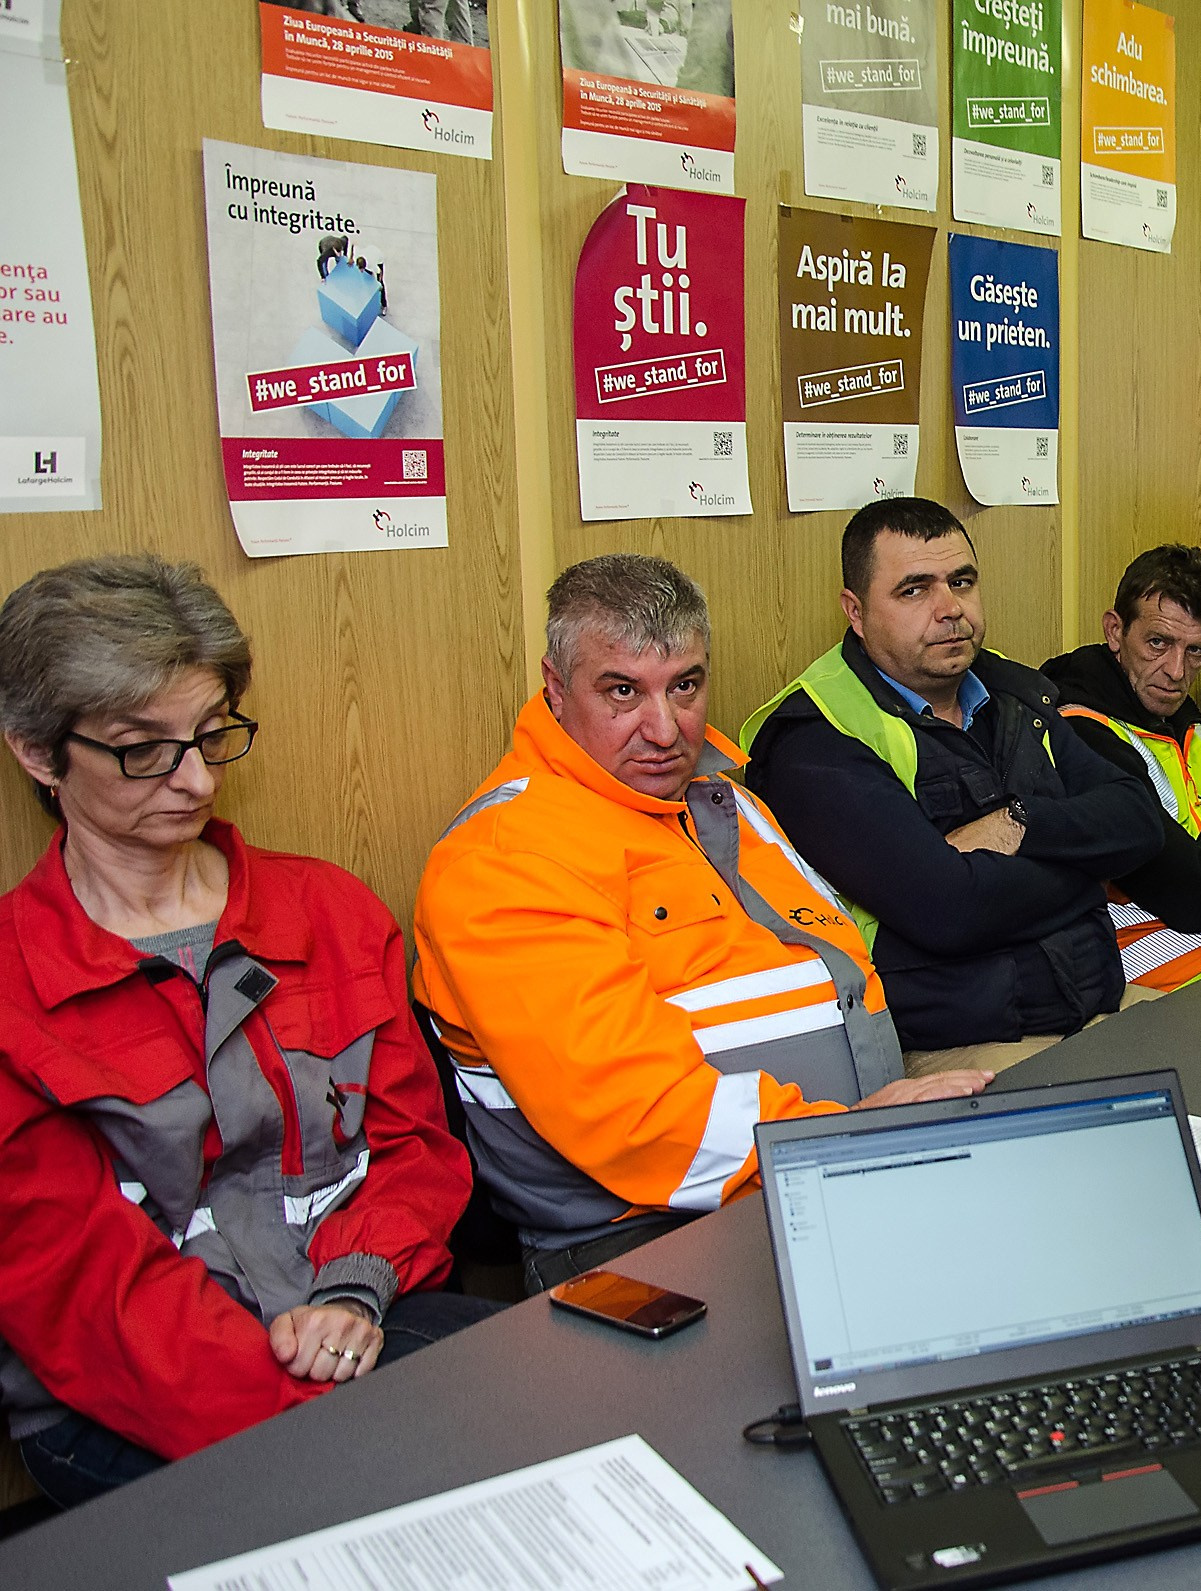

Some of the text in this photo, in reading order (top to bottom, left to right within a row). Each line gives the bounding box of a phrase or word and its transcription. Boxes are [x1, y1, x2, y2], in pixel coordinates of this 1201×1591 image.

[283, 15, 304, 29] Ziua
[355, 31, 362, 40] a
[826, 3, 916, 44] mai bună.
[284, 30, 295, 42] în
[332, 40, 343, 52] 28
[345, 41, 373, 57] aprilie
[374, 48, 394, 61] 2015
[961, 19, 1054, 74] împreună.
[1117, 31, 1143, 61] Adu
[579, 77, 595, 89] Ziua
[827, 64, 915, 87] #we_stand_for
[1090, 61, 1168, 106] schimbarea.
[615, 97, 624, 106] 28
[647, 102, 662, 112] 2015
[972, 102, 1045, 123] #we_stand_for
[434, 127, 475, 145] Holcim
[1097, 131, 1160, 151] #we_stand_for
[225, 162, 316, 201] Împreună
[689, 167, 721, 182] Holcim
[902, 188, 928, 201] Holcim
[228, 202, 361, 234] cu integritate.
[1033, 214, 1054, 226] Holcim
[626, 203, 687, 270] Tu
[796, 244, 907, 292] Aspiră la
[24, 288, 60, 302] sau
[970, 274, 1038, 314] Găsește
[3, 309, 67, 325] are au
[613, 272, 708, 352] știi.
[792, 297, 911, 338] mai mult.
[958, 317, 1051, 351] un prieten.
[255, 361, 407, 402] #we_stand_for
[603, 357, 719, 393] #we_stand_for
[804, 367, 898, 399] #we_stand_for
[968, 377, 1041, 405] #we_stand_for
[242, 449, 279, 461] Integritate
[700, 494, 735, 506] Holcim
[1027, 486, 1049, 497] Holcim
[386, 524, 430, 538] Holcim
